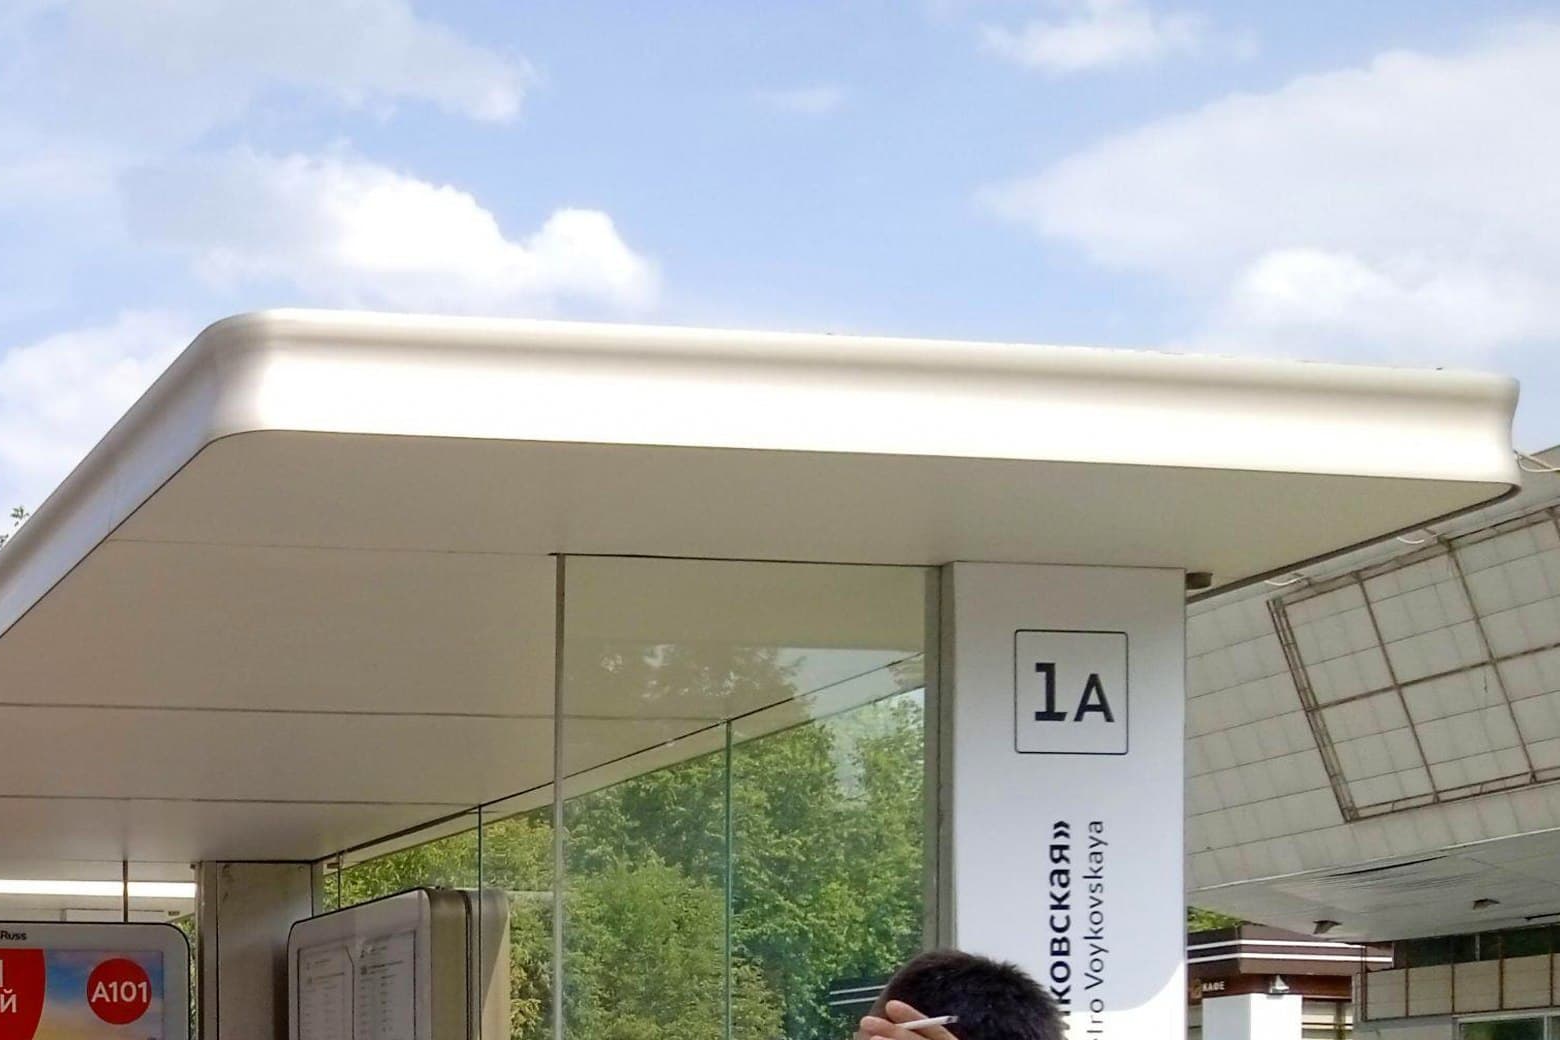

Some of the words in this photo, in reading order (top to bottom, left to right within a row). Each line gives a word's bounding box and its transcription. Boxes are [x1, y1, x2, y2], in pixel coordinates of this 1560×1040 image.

[1082, 819, 1109, 990] Voykovskaya
[0, 930, 27, 941] Russ
[90, 980, 148, 1003] А101
